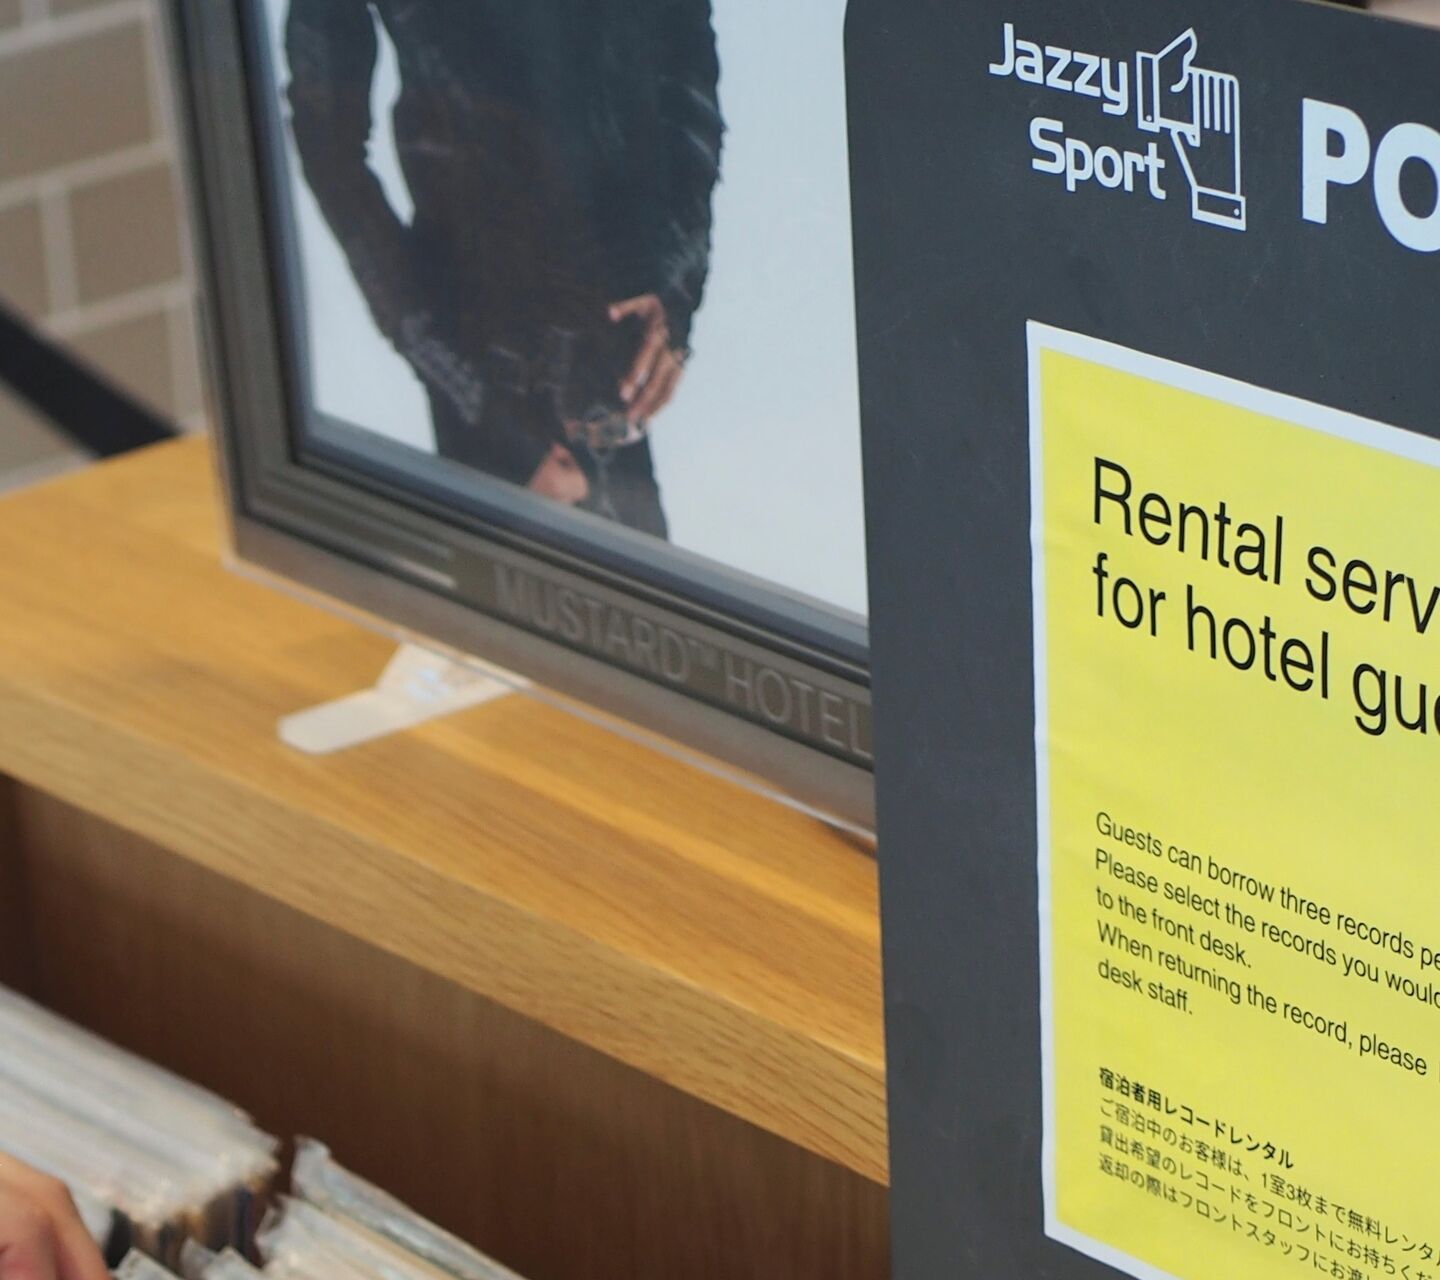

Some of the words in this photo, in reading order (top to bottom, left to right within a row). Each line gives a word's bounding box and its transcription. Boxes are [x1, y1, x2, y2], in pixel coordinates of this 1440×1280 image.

[989, 23, 1128, 115] Jazzy
[1029, 118, 1166, 200] Sport
[1093, 457, 1283, 585] Rental
[1305, 546, 1440, 634] serv
[1093, 553, 1167, 636] for
[1187, 585, 1329, 699] hotel
[1352, 663, 1440, 736] gu
[723, 651, 872, 756] HOTEL
[1095, 848, 1158, 893] Please
[1163, 879, 1220, 919] select
[1225, 903, 1256, 933] the
[1262, 920, 1337, 965] records
[1342, 953, 1379, 983] you
[1096, 811, 1162, 857] Guests
[1168, 845, 1202, 875] can
[1208, 855, 1274, 902] borrow
[1280, 886, 1331, 926] three
[1337, 913, 1414, 959] records
[1096, 886, 1114, 910] to
[1118, 895, 1148, 924] the
[1152, 909, 1194, 946] front
[1200, 931, 1252, 968] desk.
[1097, 919, 1153, 963] When
[1158, 950, 1241, 1005] returning
[1247, 983, 1277, 1014] the
[1283, 1001, 1353, 1049] record,
[1359, 1033, 1428, 1075] please
[1098, 959, 1143, 994] desk
[1148, 979, 1193, 1015] staff.
[1099, 1067, 1294, 1169] 宿泊者用レコードレンタル
